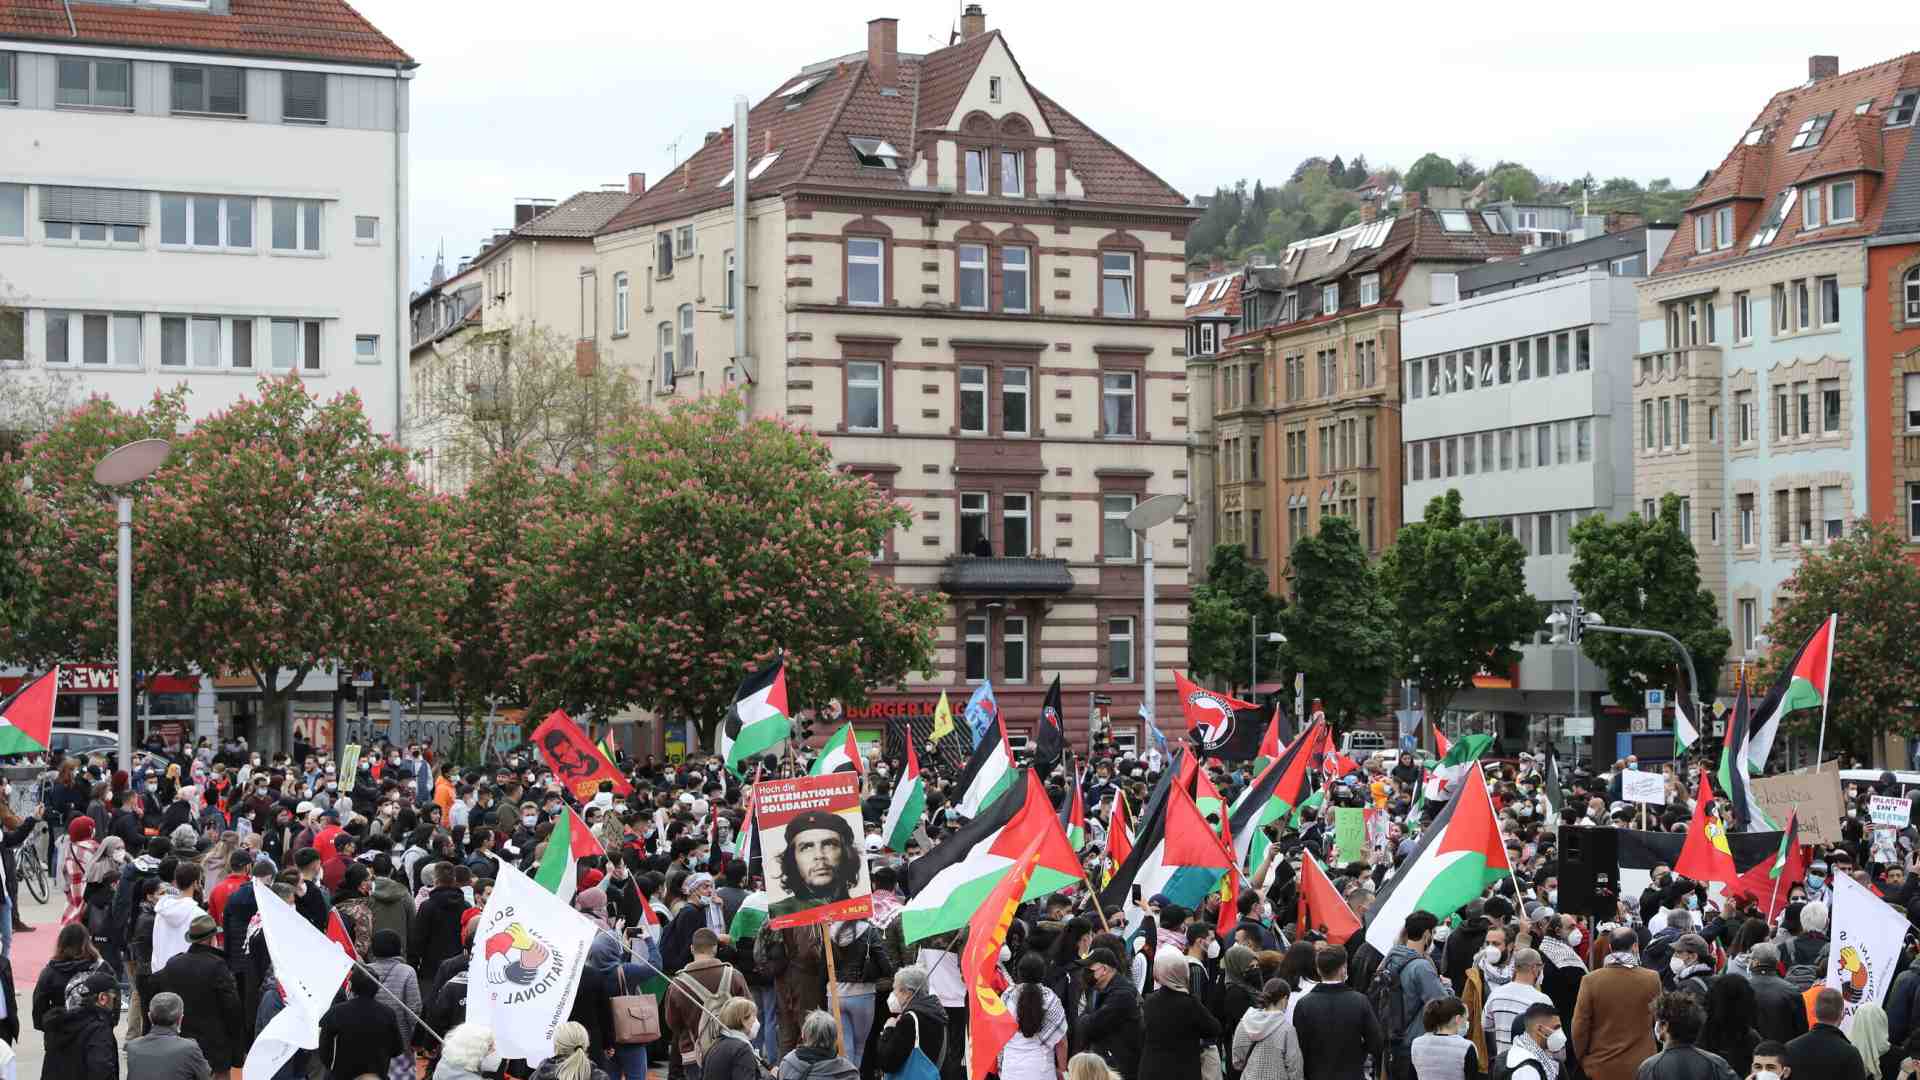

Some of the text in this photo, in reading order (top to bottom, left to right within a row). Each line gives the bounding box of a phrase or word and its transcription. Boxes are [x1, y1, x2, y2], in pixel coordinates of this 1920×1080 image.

[760, 783, 796, 794] Hoch die
[760, 785, 854, 804] INTERNATIONALE
